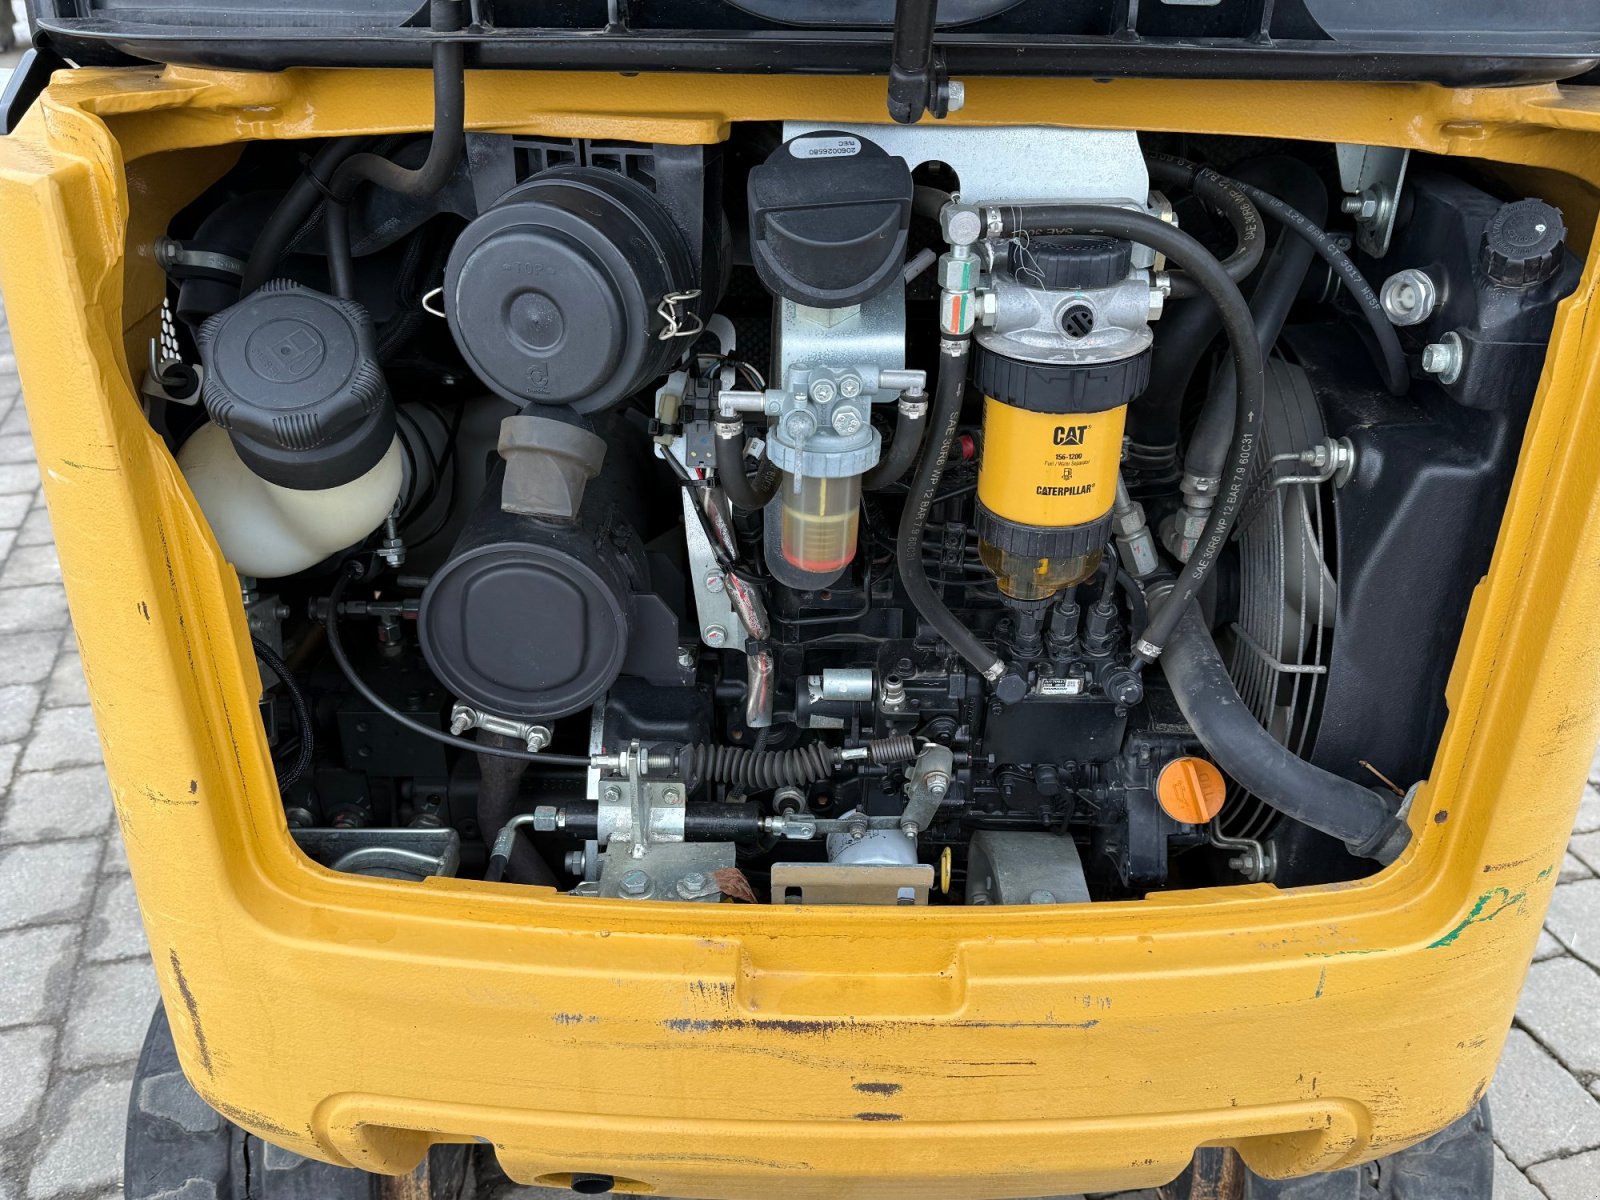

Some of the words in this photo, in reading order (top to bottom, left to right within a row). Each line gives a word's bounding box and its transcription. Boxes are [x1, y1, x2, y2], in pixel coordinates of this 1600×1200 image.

[1306, 224, 1326, 242] BAR
[946, 411, 960, 436] SAE
[1053, 425, 1088, 446] CAT
[1055, 453, 1083, 461] 156-1200
[1239, 433, 1254, 465] 60C31
[1036, 484, 1093, 497] CATERPILLAR
[1226, 483, 1242, 505] BAR
[1223, 505, 1234, 516] 12
[1214, 518, 1228, 534] WP
[1203, 535, 1221, 559] 30R6
[1193, 560, 1210, 580] SAE
